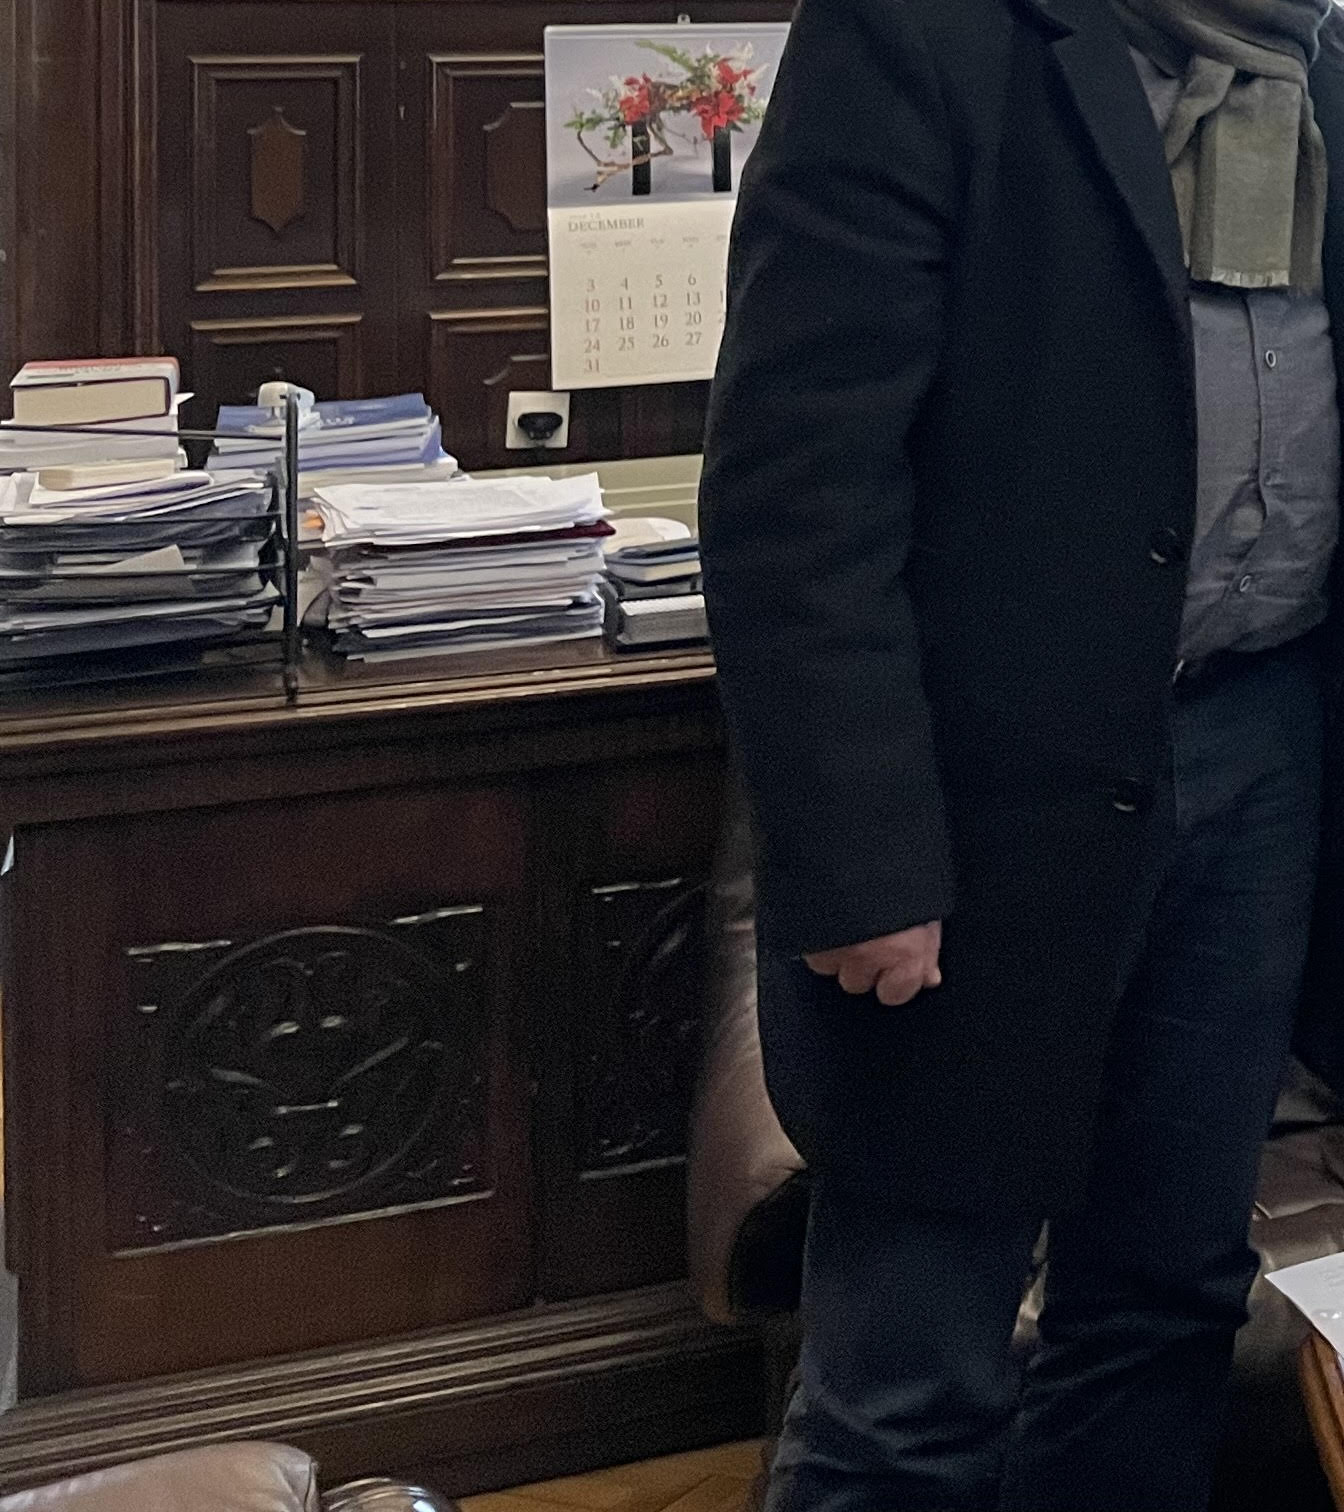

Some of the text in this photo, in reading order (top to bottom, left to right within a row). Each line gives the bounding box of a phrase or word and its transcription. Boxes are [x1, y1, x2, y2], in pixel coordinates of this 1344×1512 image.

[568, 217, 645, 232] DECEMBER
[586, 278, 596, 292] 3
[655, 274, 663, 288] 5
[687, 273, 697, 286] 6
[584, 298, 600, 313] 10
[619, 296, 633, 311] 11
[653, 293, 668, 308] 12
[686, 291, 701, 306] 13
[585, 318, 600, 333] 17
[619, 316, 635, 331] 18
[654, 314, 669, 328] 19
[685, 311, 702, 326] 20
[584, 331, 702, 354] 24 25 26 27
[584, 358, 600, 374] 31
